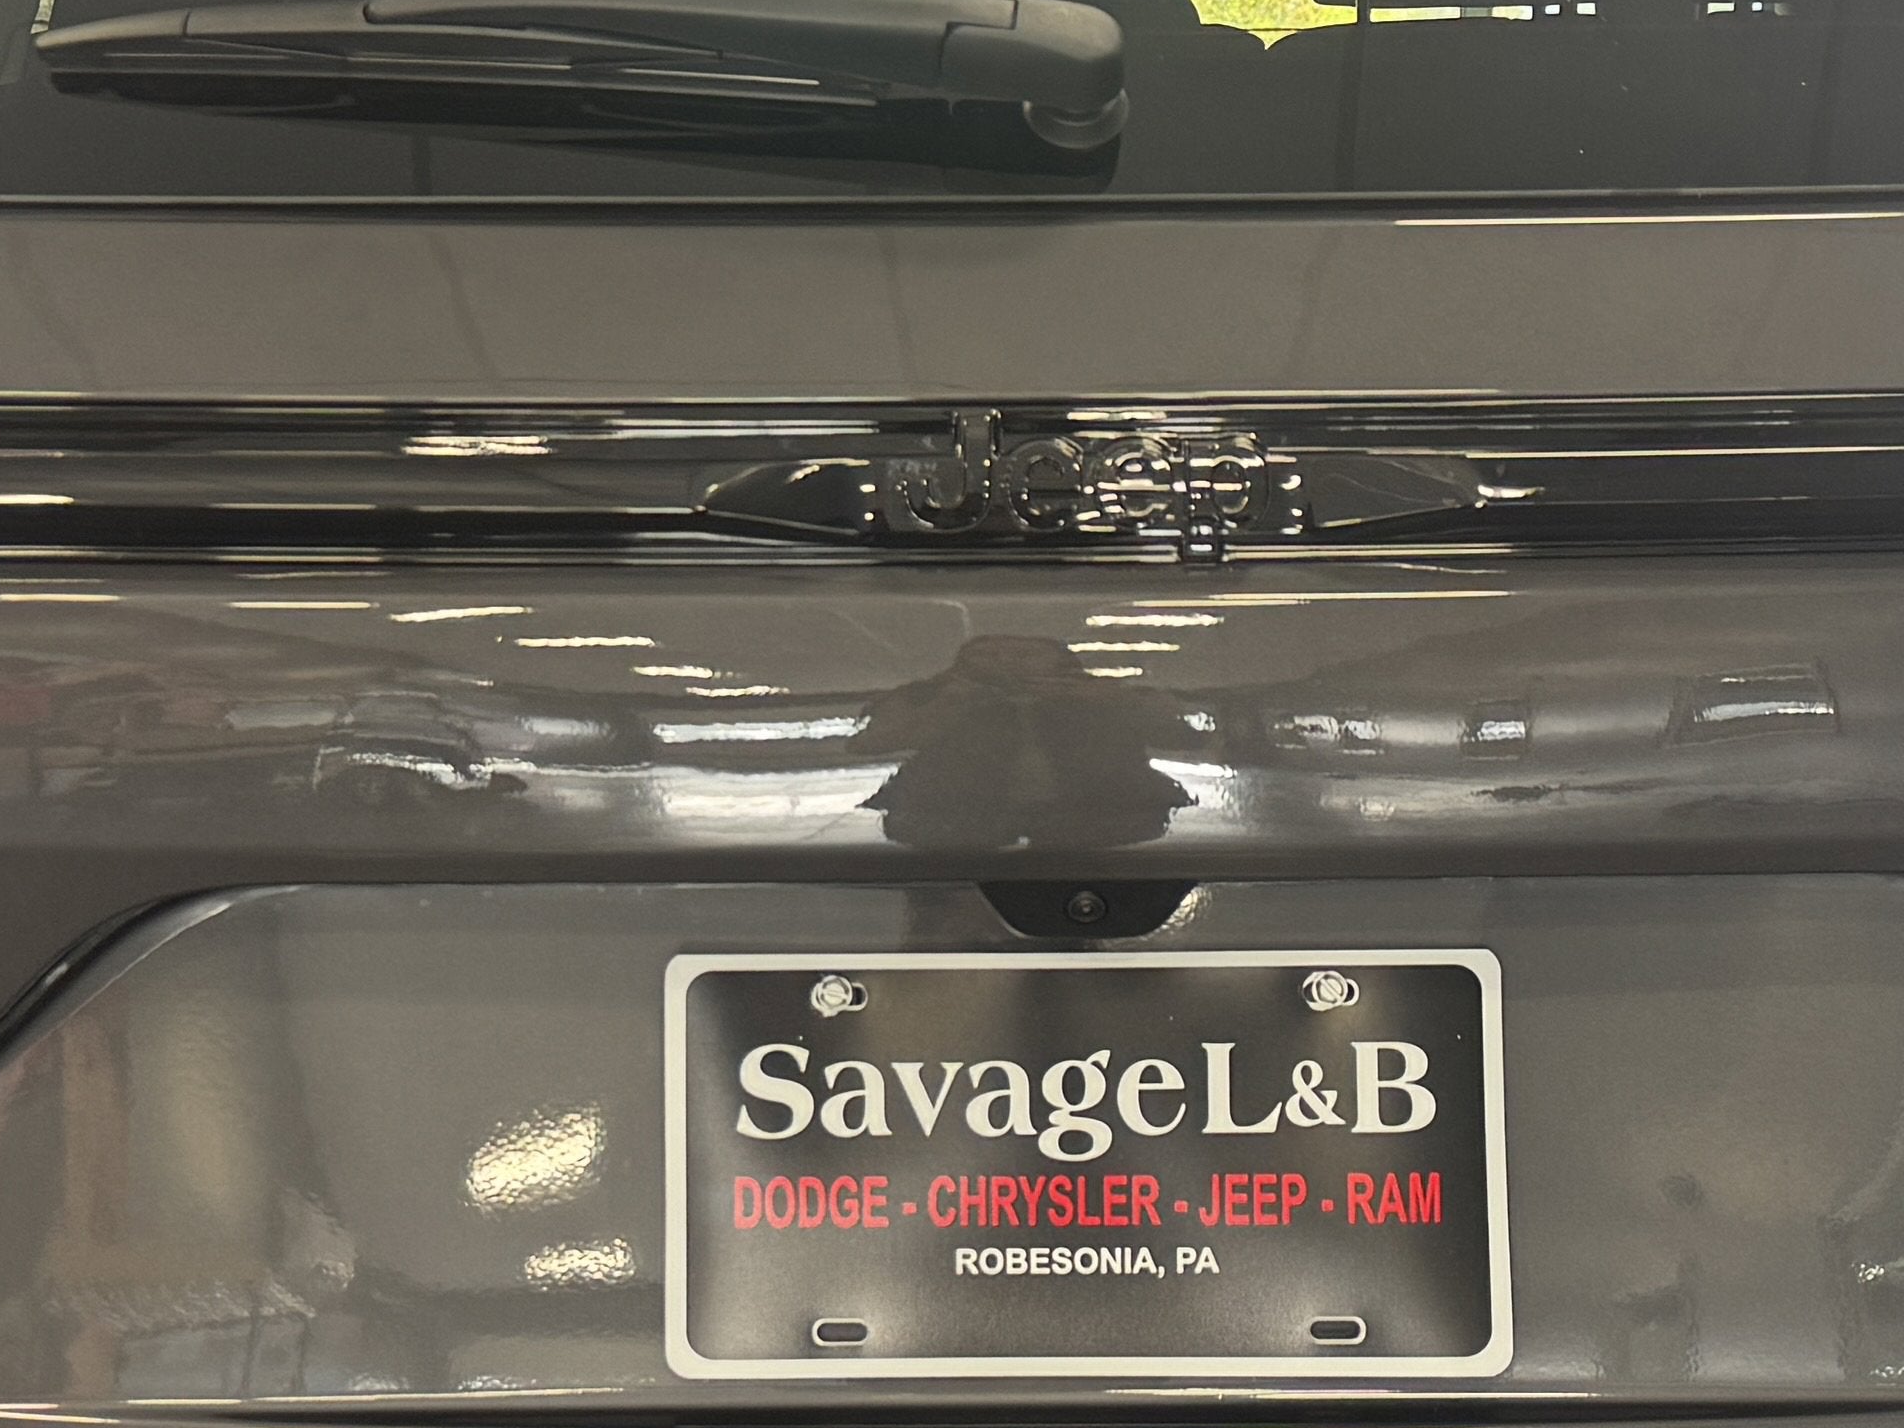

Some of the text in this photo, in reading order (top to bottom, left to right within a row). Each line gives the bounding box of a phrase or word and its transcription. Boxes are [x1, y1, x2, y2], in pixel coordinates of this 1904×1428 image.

[897, 408, 1269, 562] Jeep
[733, 1175, 889, 1229] DODGE
[927, 1173, 1161, 1229] CHRYSLER
[1198, 1172, 1308, 1227] JEEP
[1346, 1171, 1442, 1226] RAM
[955, 1246, 1220, 1279] ROBESONIA, PA
